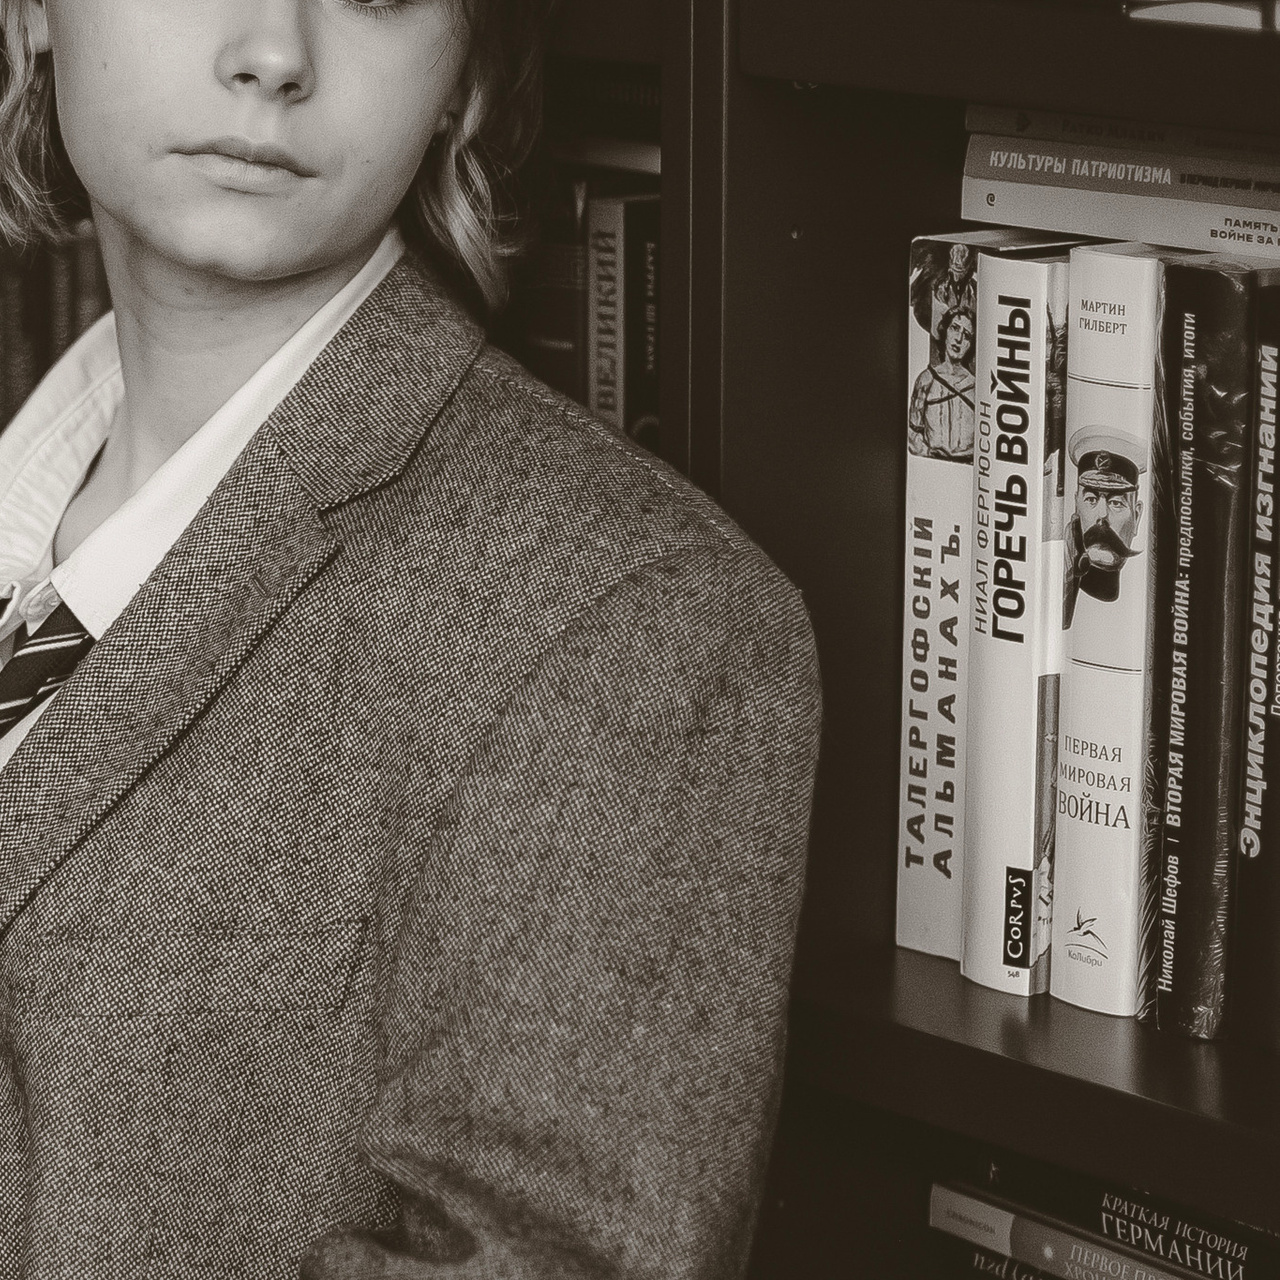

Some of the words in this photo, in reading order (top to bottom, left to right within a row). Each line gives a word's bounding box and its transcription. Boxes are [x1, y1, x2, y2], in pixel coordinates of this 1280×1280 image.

[989, 150, 1067, 174] КУЛЬТУРЫ
[1071, 158, 1172, 187] ПАТРИОТИЗМА
[1210, 227, 1254, 244] ВОЙНЕ
[1256, 234, 1274, 246] ЗА
[1224, 217, 1279, 234] ПАМЯТЬ
[1078, 317, 1128, 335] ГИЛБЕРТ
[1080, 299, 1126, 316] МАРТИН
[1184, 312, 1197, 359] итоги
[990, 294, 1032, 466] ВОЙНЫ
[976, 400, 991, 550] ФЕРГЮСОН
[1255, 345, 1280, 540] изгнаний
[991, 472, 1030, 644] ГОРЕЧЬ
[975, 559, 989, 634] НИАЛ
[1173, 570, 1191, 647] ВОЙНА:
[1169, 651, 1188, 747] МИРОВАЯ
[1241, 547, 1274, 857] Энциклопедия
[1059, 762, 1132, 793] МИРОВАЯ
[1064, 734, 1123, 763] ПЕРВАЯ
[1058, 792, 1131, 830] ВОЙНА
[1166, 755, 1186, 828] ВТОРАЯ
[1161, 854, 1181, 914] Шефов
[1158, 919, 1178, 993] Николай
[1102, 1193, 1170, 1231] КРАТКАЯ
[1175, 1220, 1249, 1261] ИСТОРИЯ
